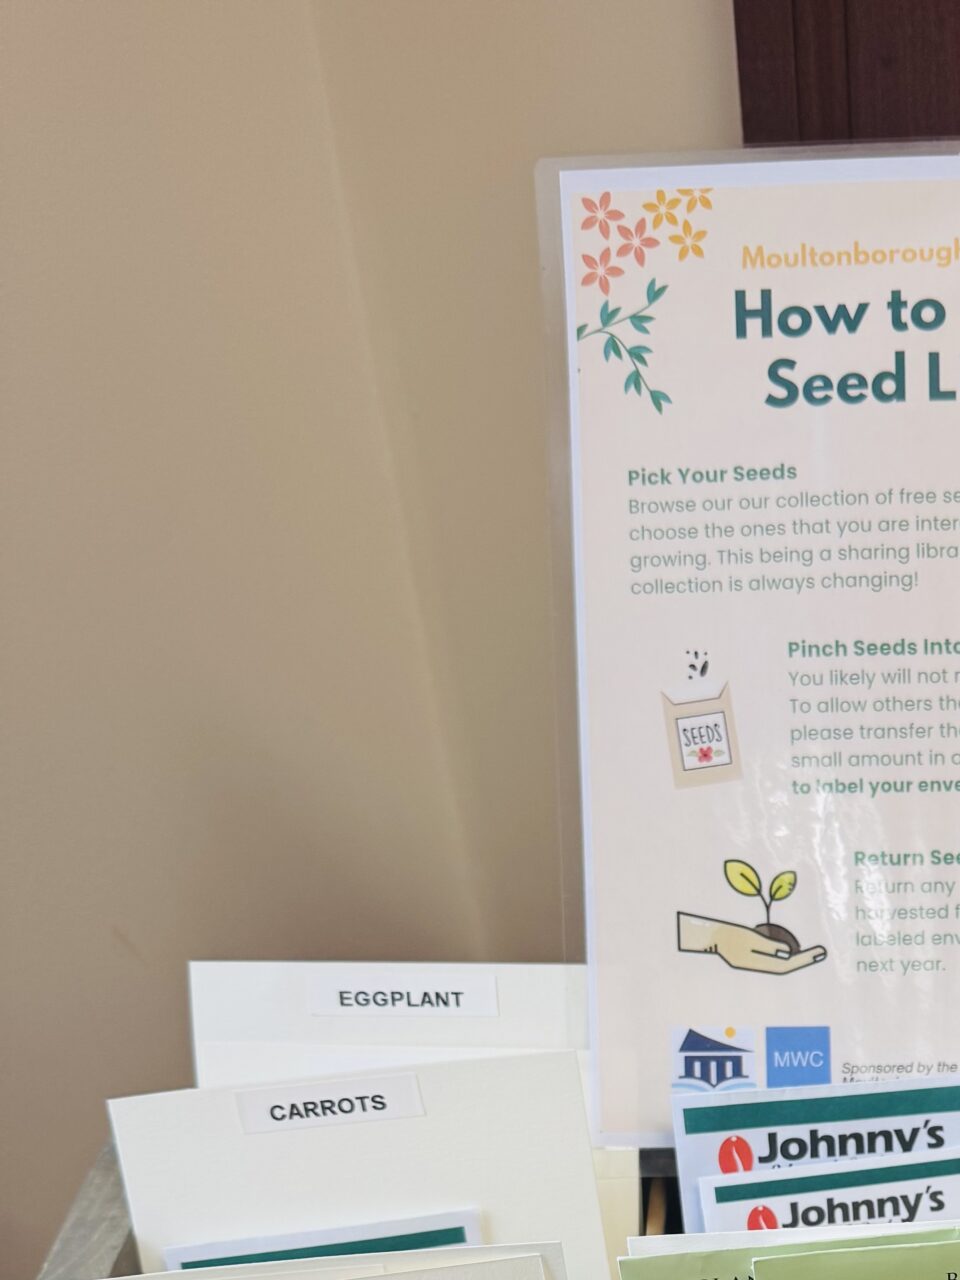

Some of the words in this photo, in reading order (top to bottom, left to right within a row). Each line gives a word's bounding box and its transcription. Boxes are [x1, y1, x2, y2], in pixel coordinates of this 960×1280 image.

[734, 287, 869, 340] How
[888, 288, 946, 333] to
[765, 349, 906, 409] Seed
[628, 468, 672, 486] Pick
[678, 467, 727, 484] Your
[733, 463, 798, 482] Seeds
[629, 499, 696, 514] Browse
[702, 498, 733, 512] our
[739, 496, 770, 511] our
[776, 490, 869, 509] collection
[875, 488, 893, 505] of
[900, 487, 937, 504] free
[629, 525, 699, 541] choose
[704, 522, 735, 539] the
[741, 523, 786, 537] ones
[793, 518, 831, 535] that
[837, 519, 872, 538] you
[878, 517, 909, 532] are
[630, 551, 711, 573] growing.
[718, 548, 754, 565] This
[760, 546, 813, 567] being
[819, 549, 832, 562] a
[838, 543, 910, 564] sharing
[631, 577, 723, 595] collection
[729, 576, 743, 592] is
[749, 574, 815, 594] always
[821, 571, 918, 592] changing!
[788, 639, 847, 657] Pinch
[853, 638, 917, 656] Seeds
[789, 670, 823, 686] You
[829, 669, 875, 690] likely
[881, 668, 911, 684] will
[918, 668, 948, 684] not
[789, 699, 811, 713] To
[817, 697, 867, 713] allow
[873, 696, 932, 712] others
[683, 723, 722, 747] SEEDS
[792, 780, 810, 794] to
[868, 780, 912, 798] your
[854, 851, 924, 866] Return
[339, 991, 464, 1008] EGGPLANT
[774, 1051, 824, 1068] MWC
[842, 1061, 913, 1076] Sponsored
[917, 1062, 933, 1076] by
[936, 1061, 958, 1073] the
[270, 1094, 387, 1122] CARROTS
